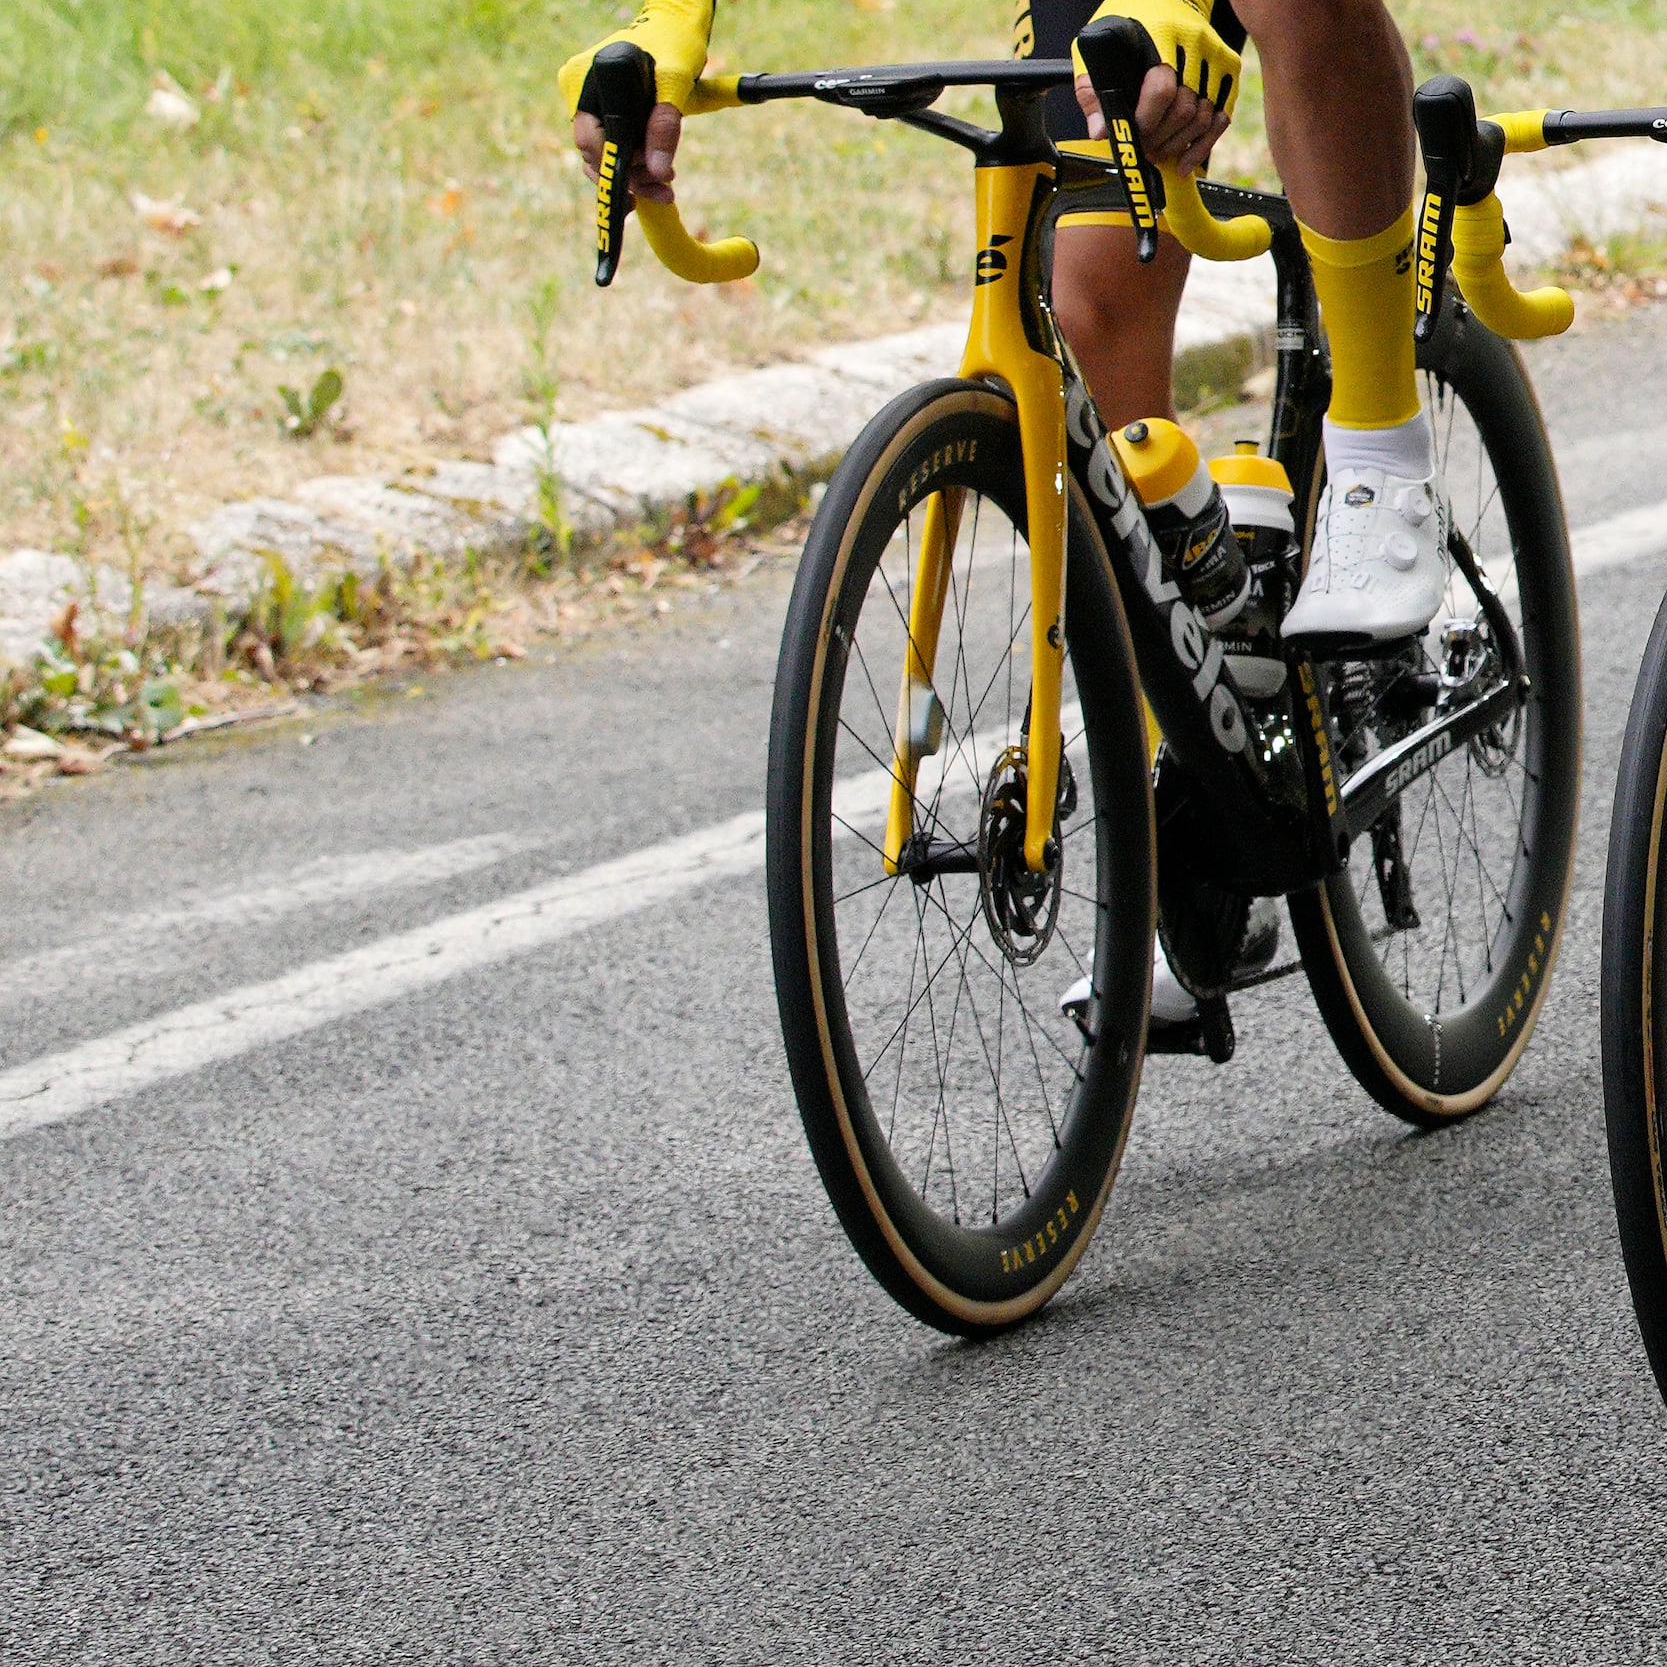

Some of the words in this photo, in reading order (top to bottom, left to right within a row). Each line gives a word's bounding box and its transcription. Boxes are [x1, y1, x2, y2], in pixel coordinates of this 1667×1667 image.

[849, 87, 886, 96] GARMIN
[597, 140, 618, 253] SRAM
[1112, 119, 1155, 228] SRAM
[1417, 192, 1442, 315] SRAM
[1203, 589, 1237, 613] RMIN
[1384, 730, 1453, 799] SRAM
[999, 1189, 1081, 1274] RESERVE
